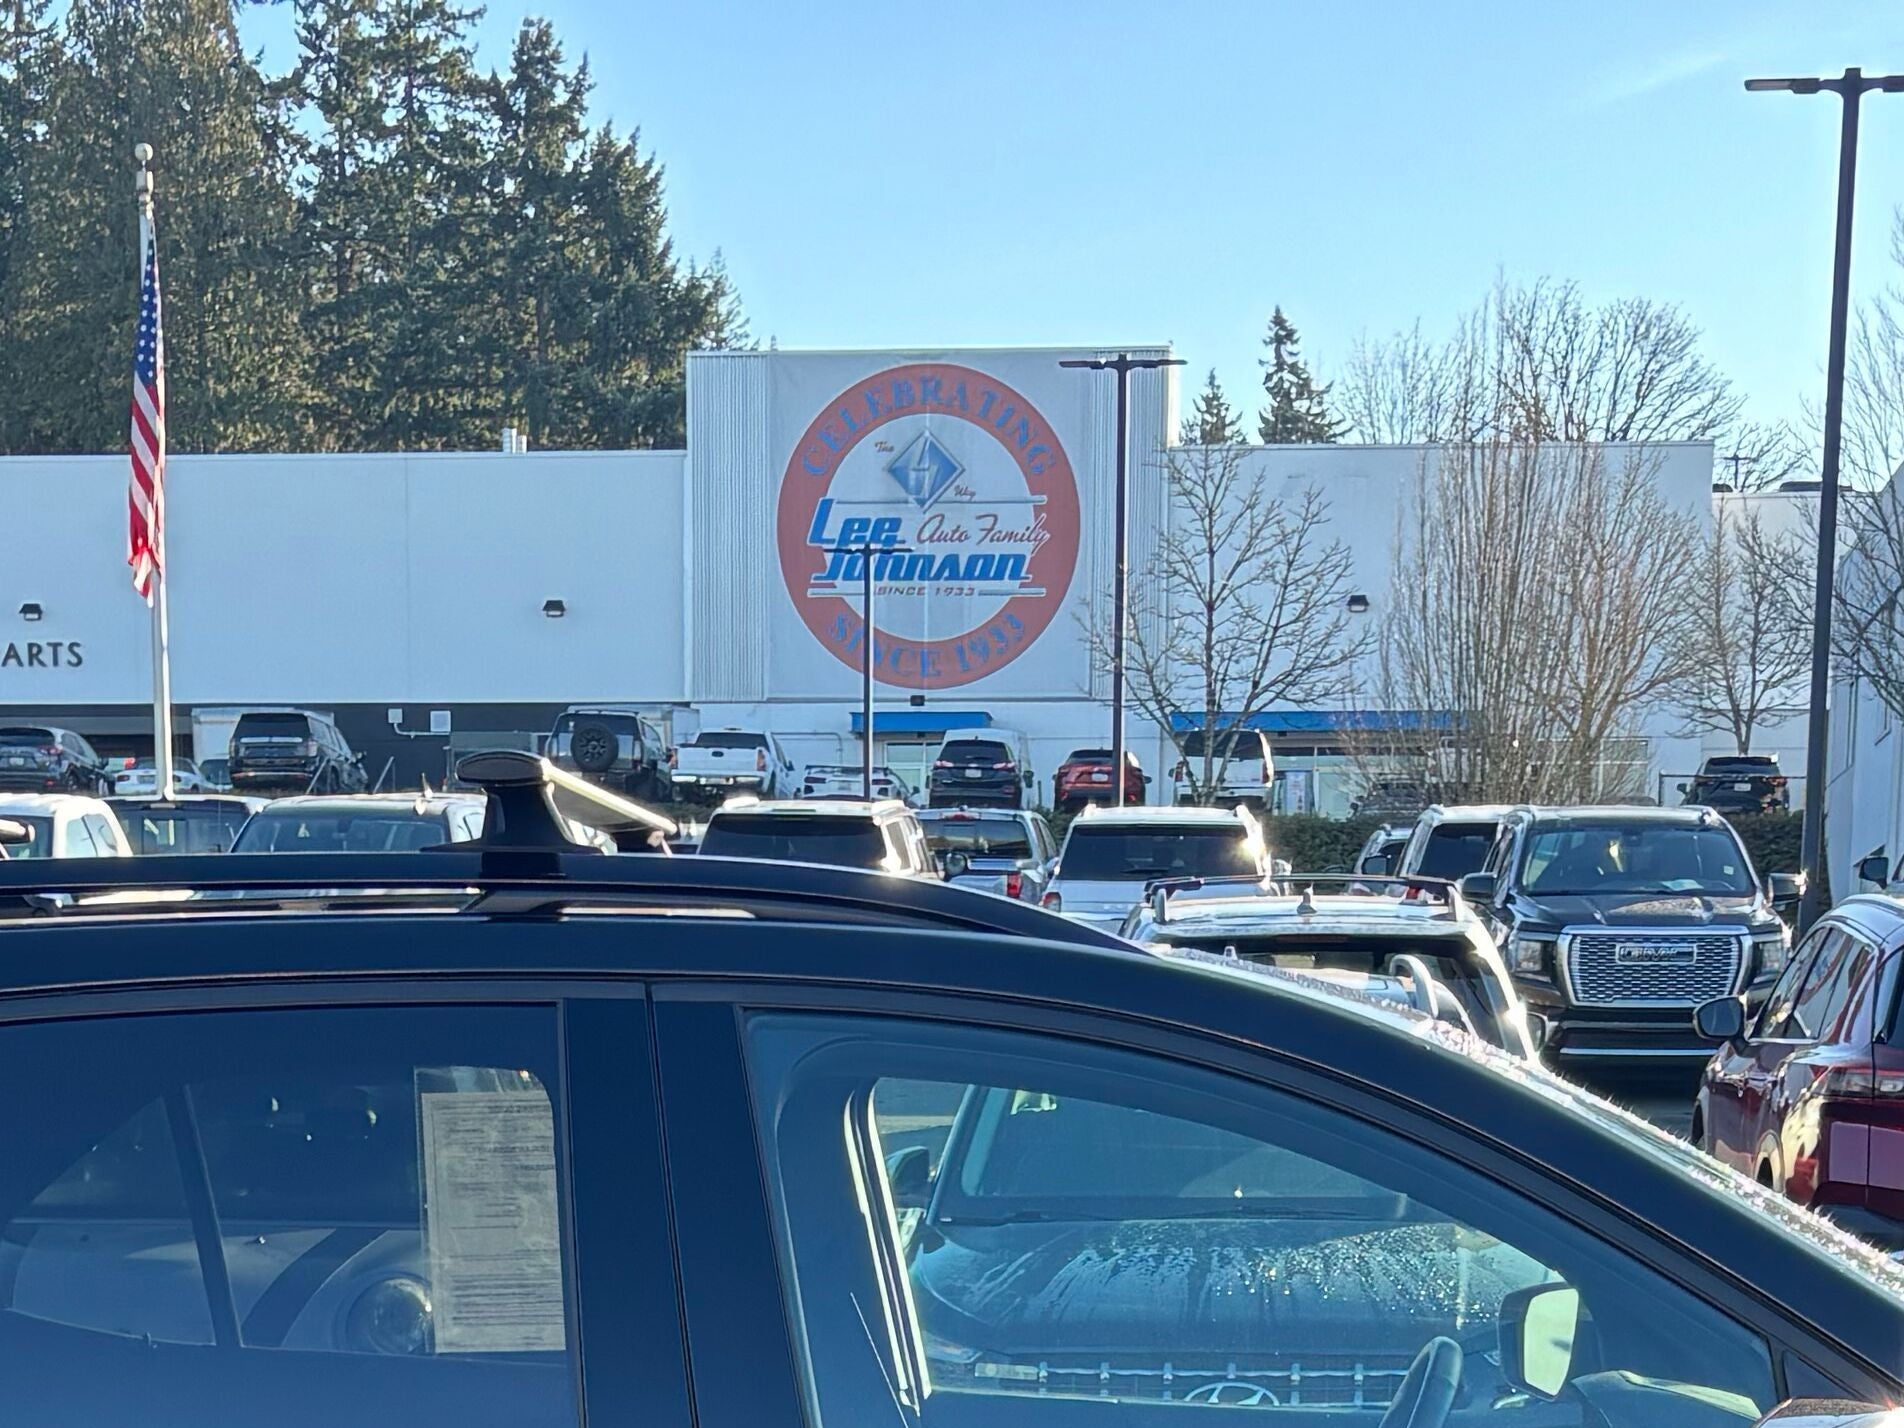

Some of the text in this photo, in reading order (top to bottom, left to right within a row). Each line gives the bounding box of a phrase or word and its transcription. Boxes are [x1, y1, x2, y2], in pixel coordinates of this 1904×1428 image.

[801, 373, 1056, 476] CELEBRATING
[809, 498, 907, 548] Lee
[916, 512, 1051, 557] Auto Family
[877, 585, 976, 597] SINCE 1933
